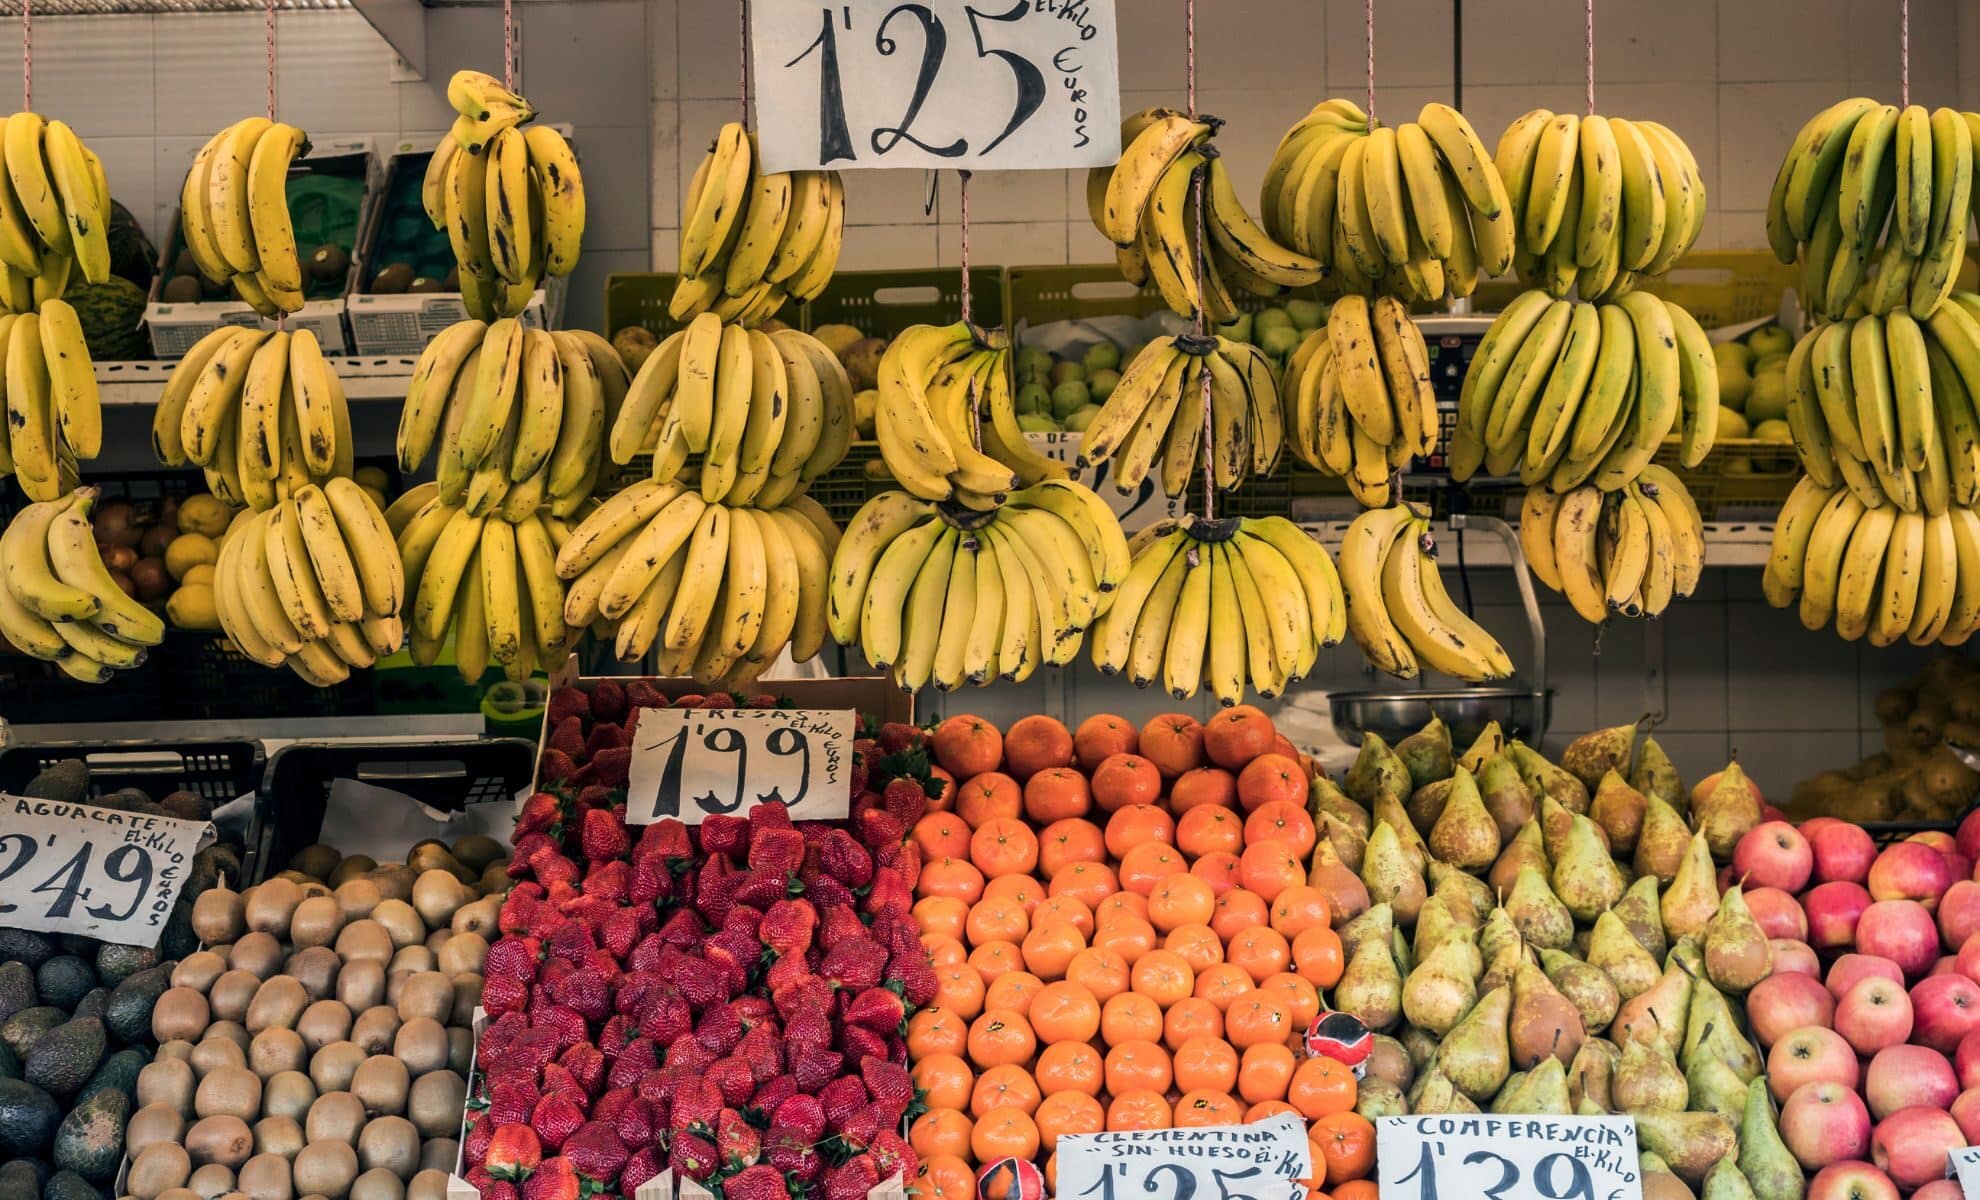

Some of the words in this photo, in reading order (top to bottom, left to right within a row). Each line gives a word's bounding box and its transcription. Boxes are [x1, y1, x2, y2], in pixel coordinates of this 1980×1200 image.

[784, 0, 1046, 166] 1'25
[645, 723, 810, 817] 1'99
[0, 833, 154, 922] 2'49
